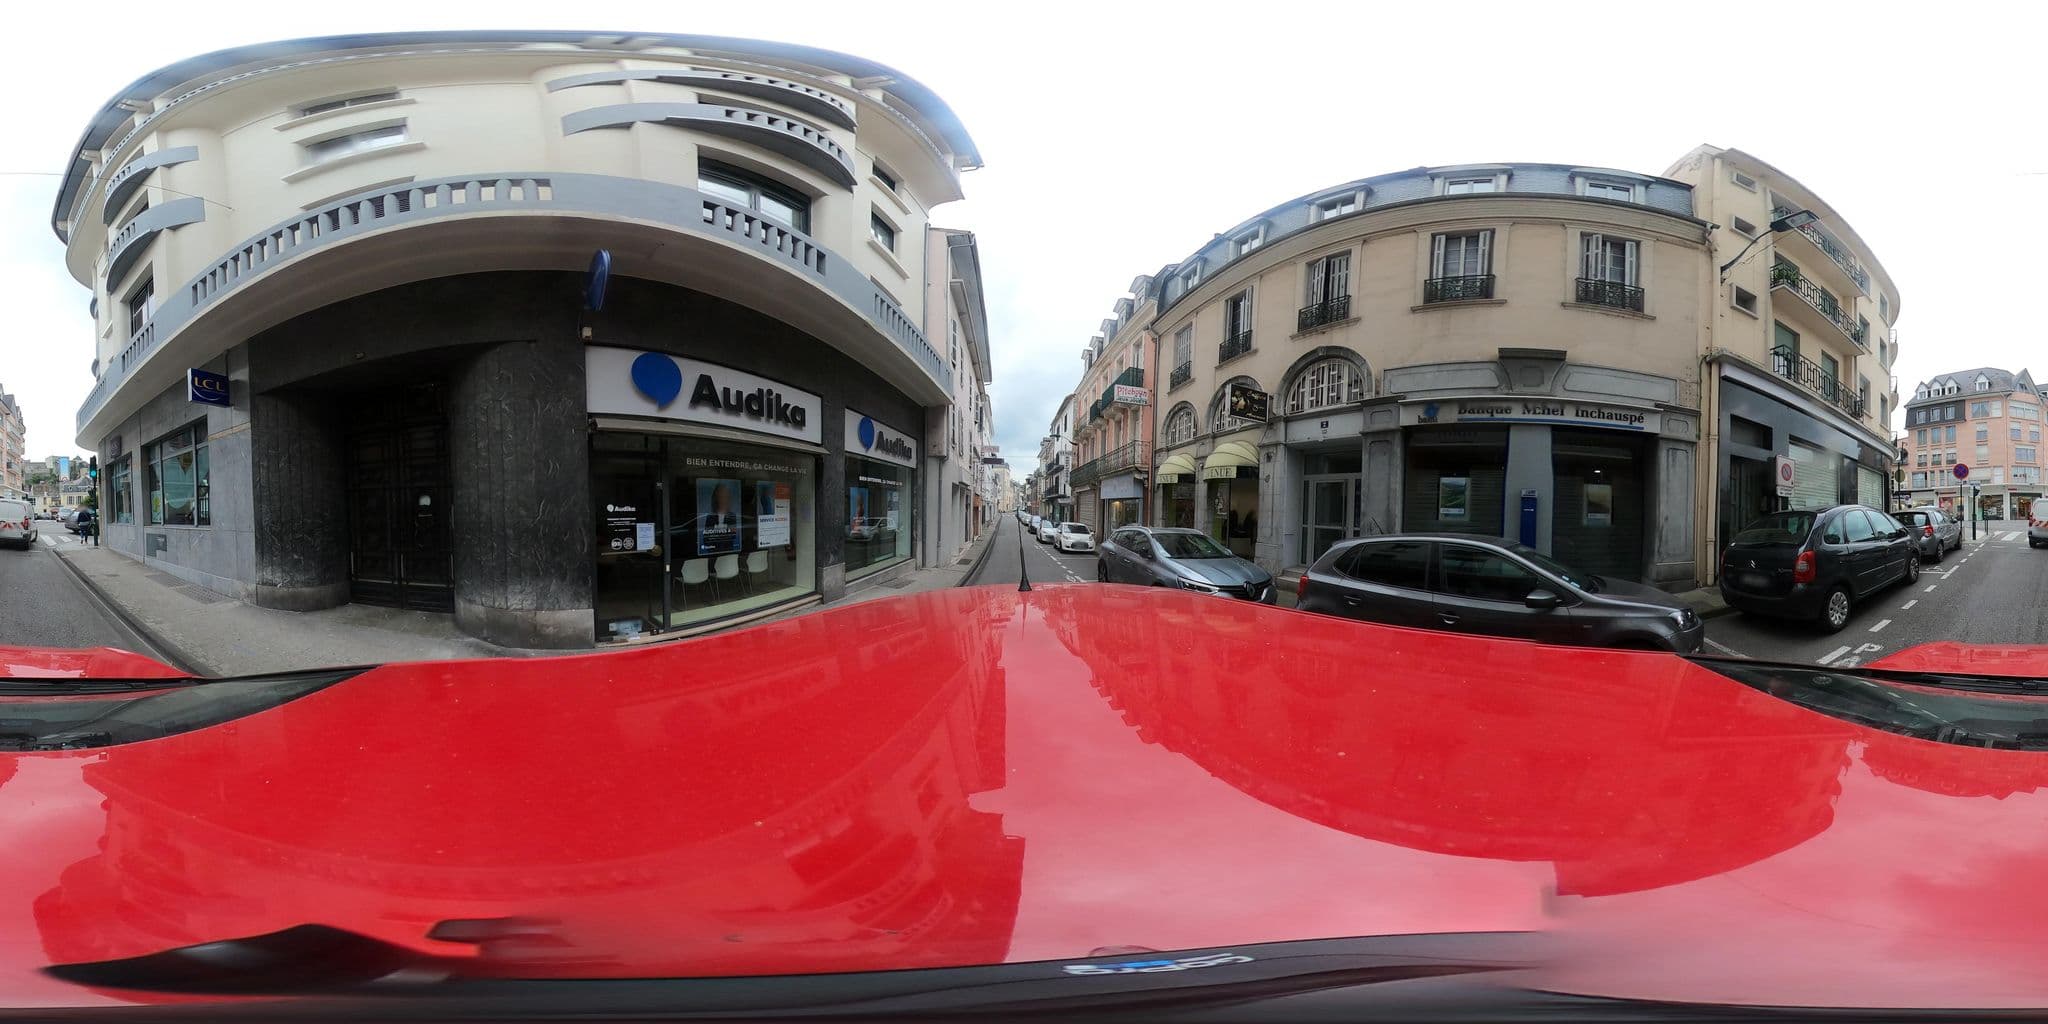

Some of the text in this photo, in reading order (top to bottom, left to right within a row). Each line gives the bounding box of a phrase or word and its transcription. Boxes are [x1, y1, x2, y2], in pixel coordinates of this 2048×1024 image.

[194, 376, 226, 392] LCL
[688, 373, 806, 428] Audika
[1575, 407, 1645, 425] Inchauspé
[686, 457, 707, 466] BIEN
